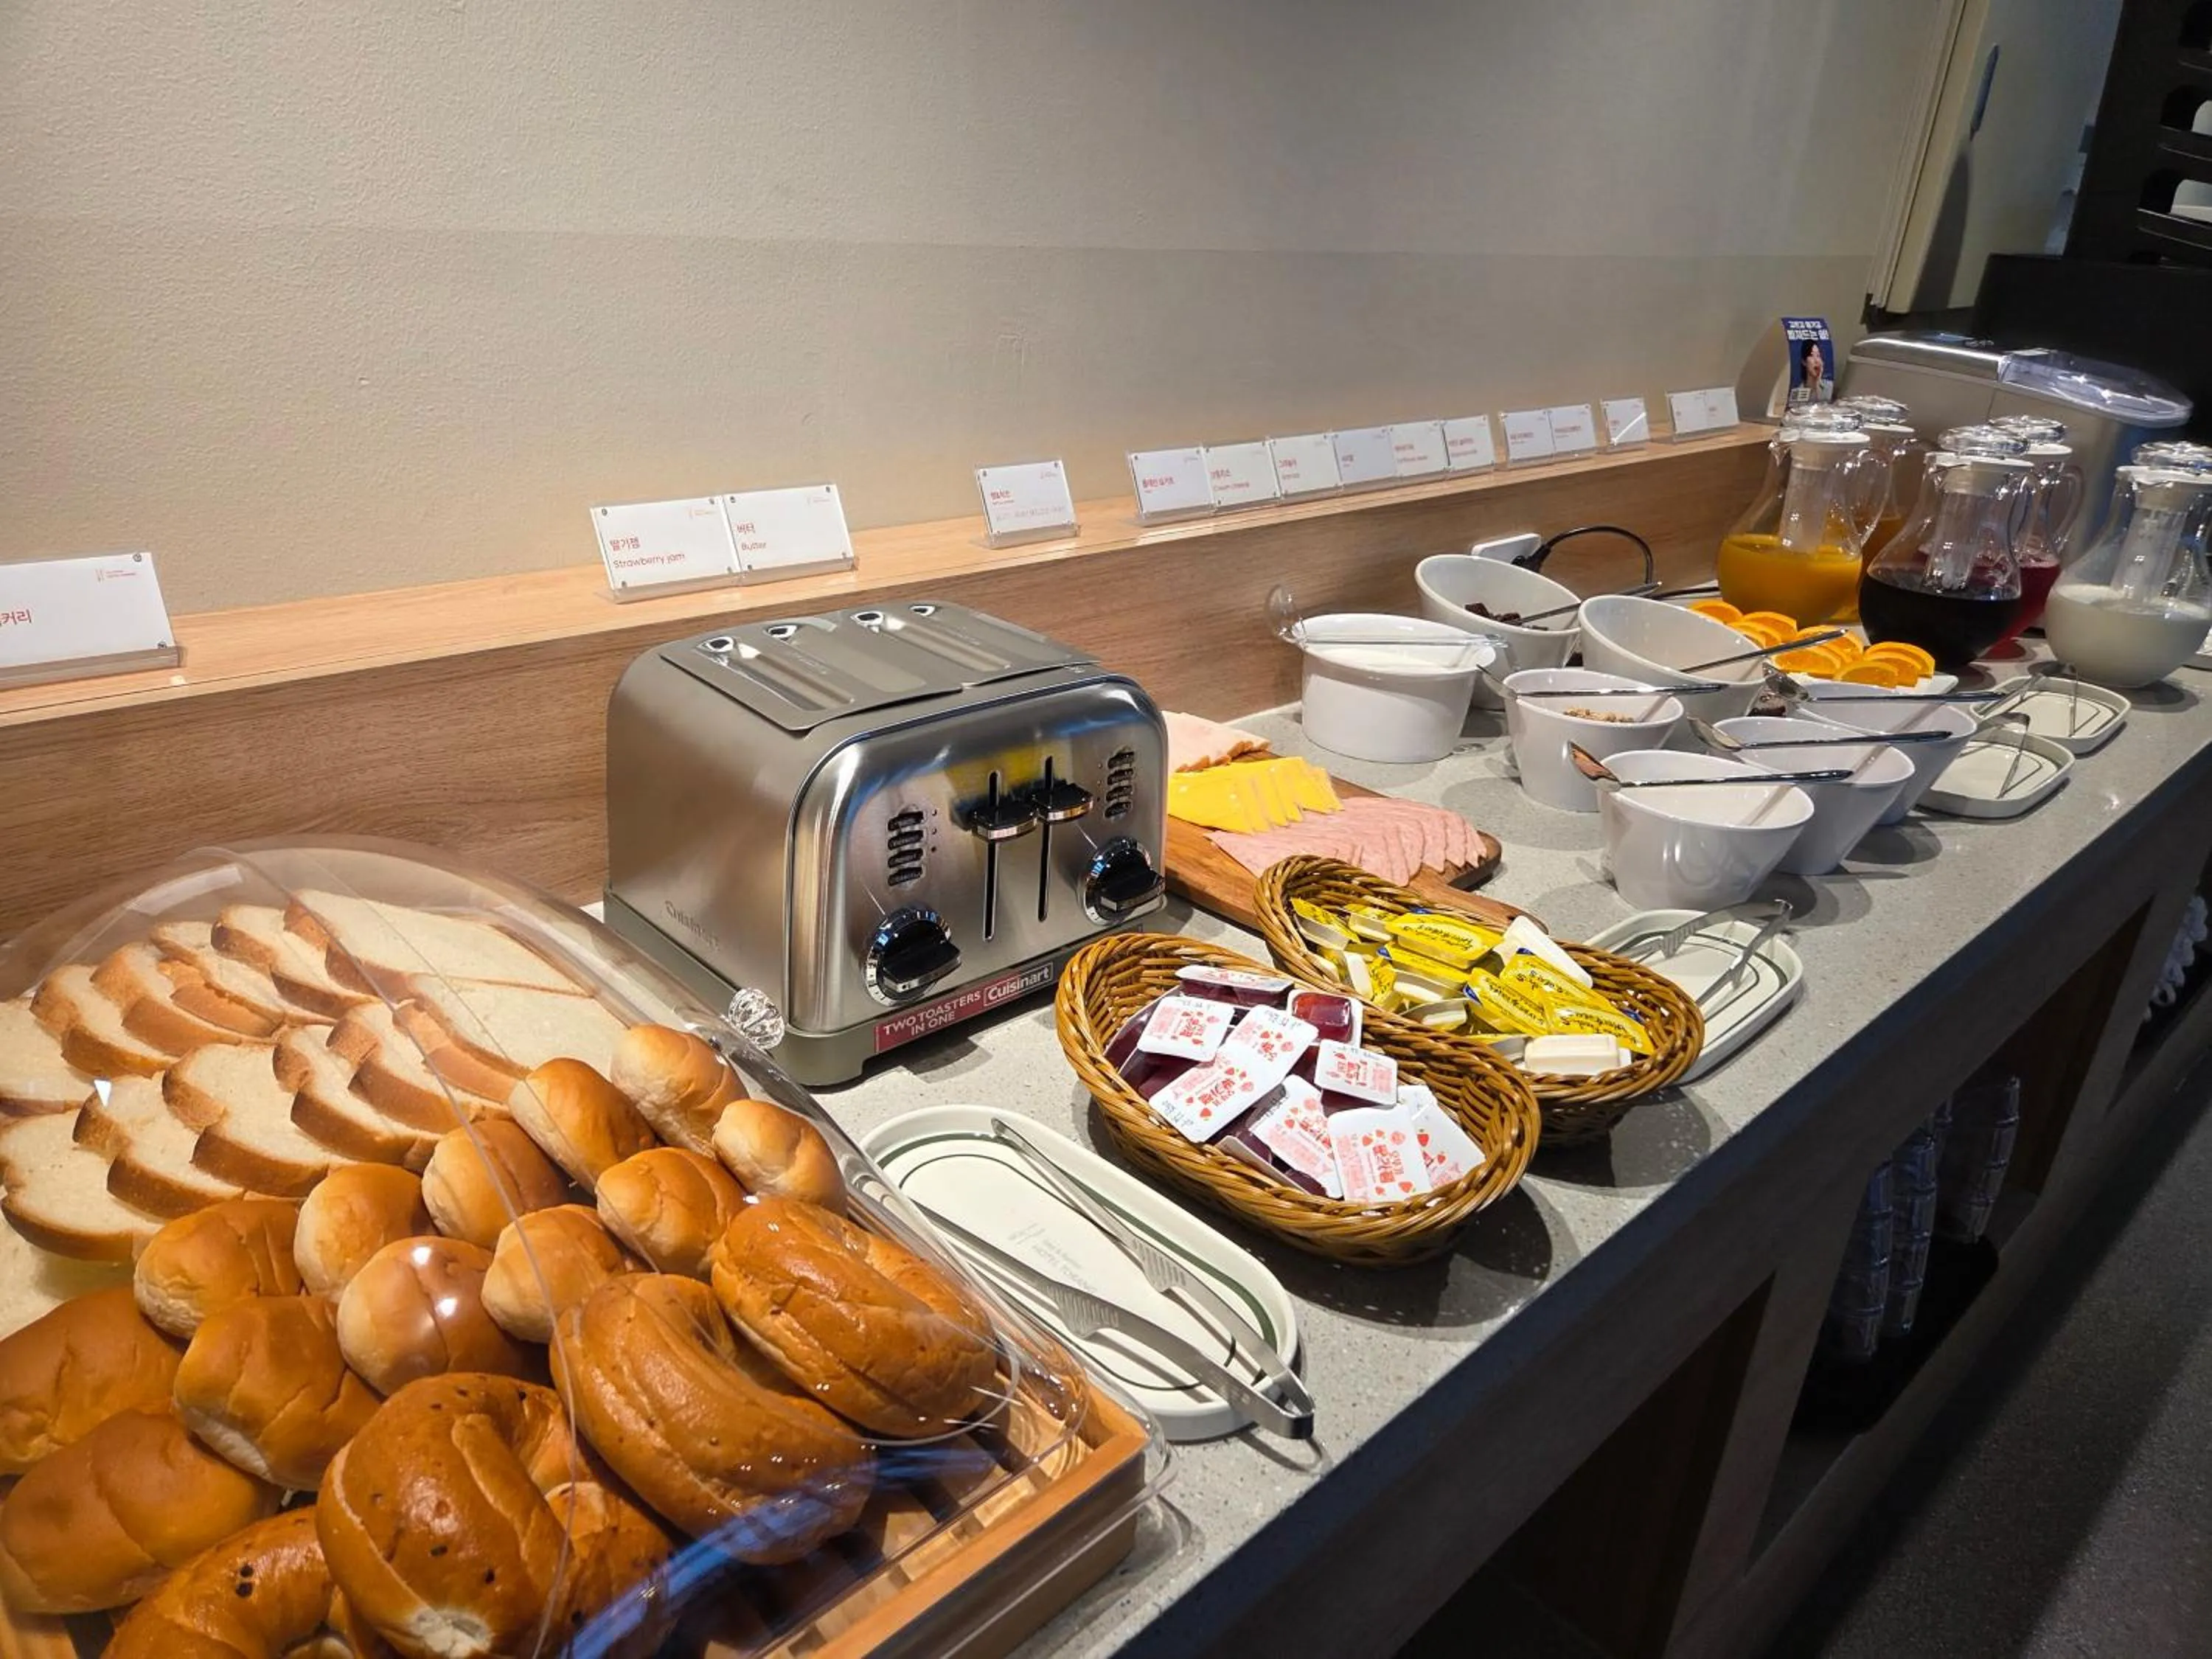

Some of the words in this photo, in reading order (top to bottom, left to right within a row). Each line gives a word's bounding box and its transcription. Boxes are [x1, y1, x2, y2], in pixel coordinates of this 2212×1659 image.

[613, 554, 664, 568] Strawberry
[0, 609, 32, 626] 커리
[883, 1016, 917, 1036] TWO
[919, 991, 981, 1023] TOASTERS
[987, 967, 1050, 1001] Cuisinart
[911, 1022, 925, 1036] IN
[928, 1011, 956, 1027] ONE
